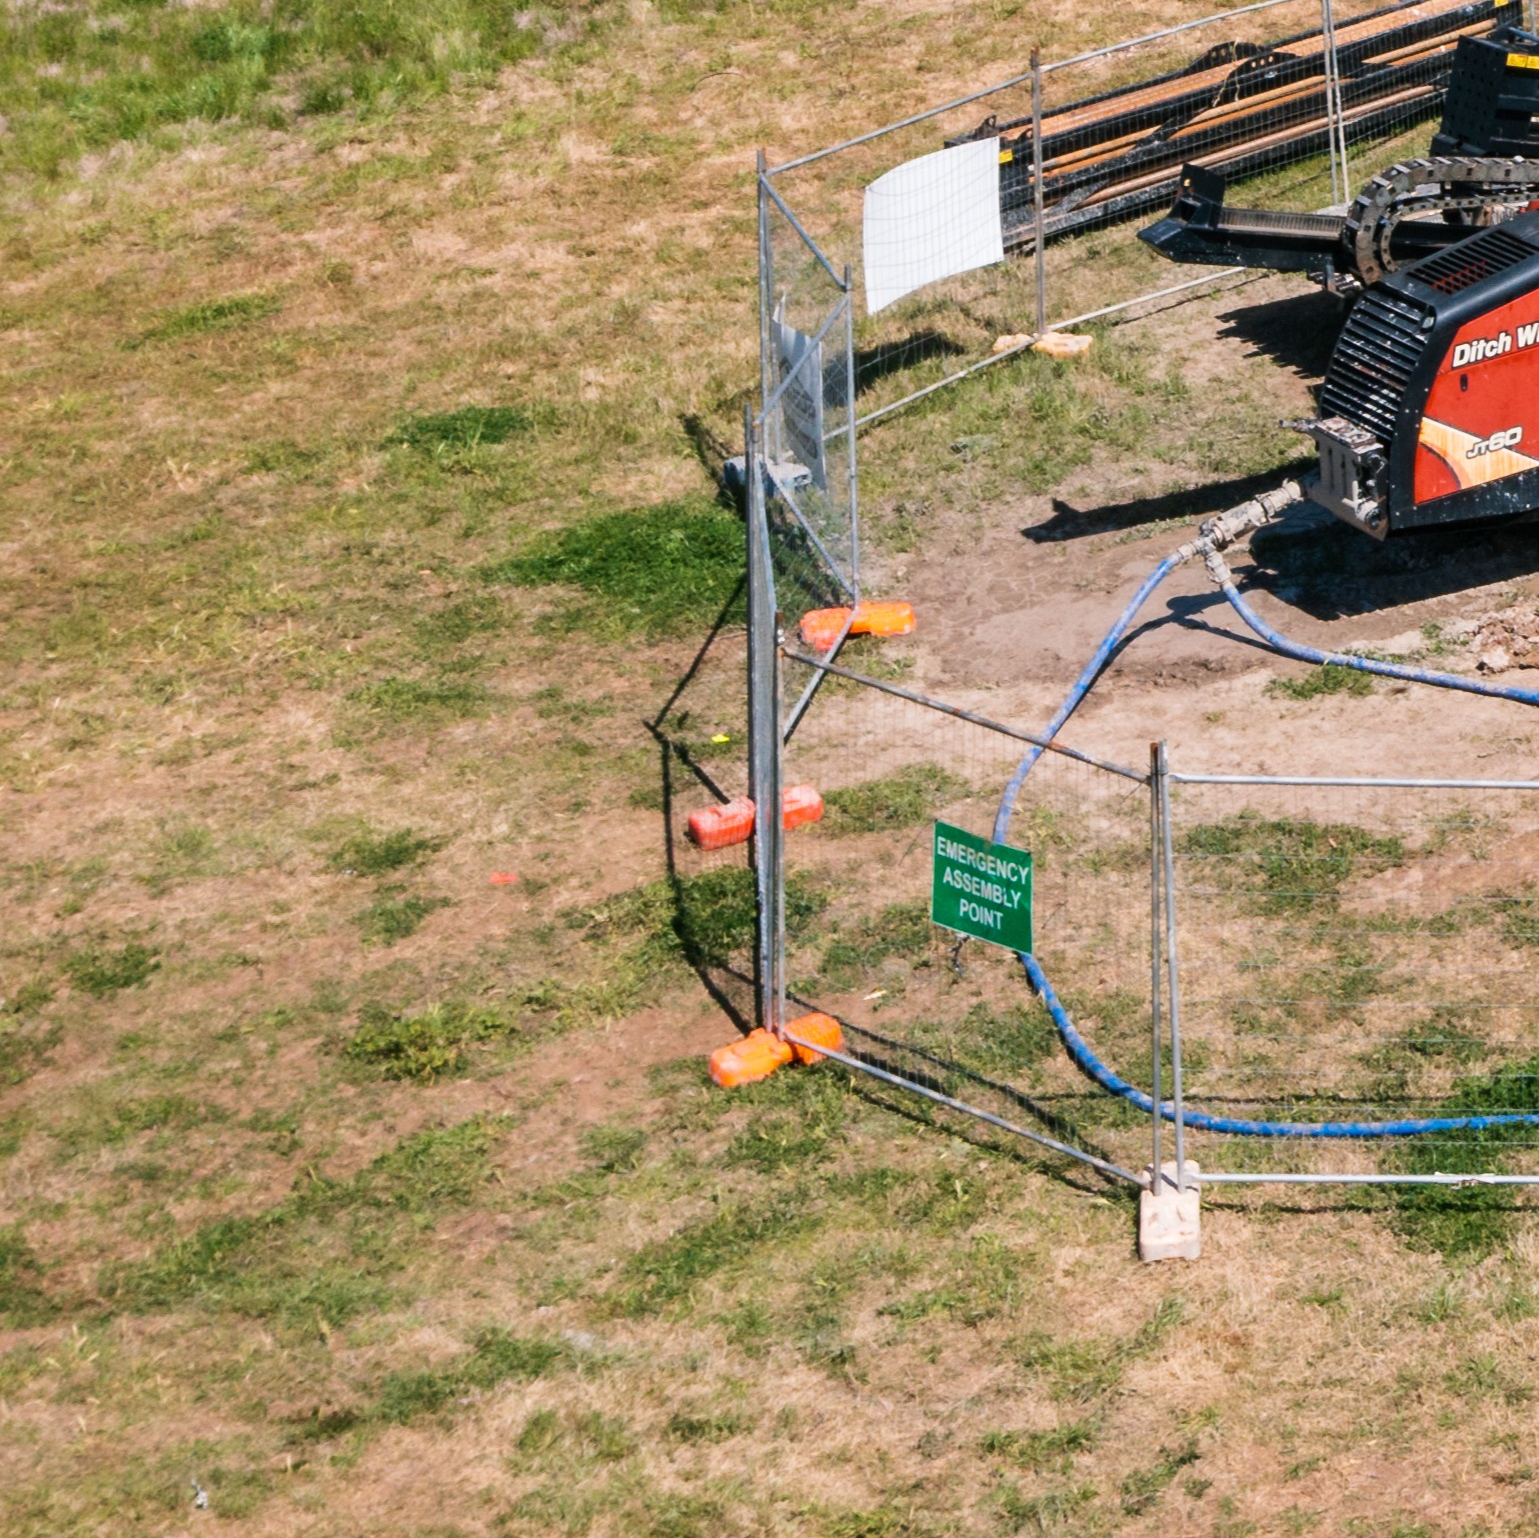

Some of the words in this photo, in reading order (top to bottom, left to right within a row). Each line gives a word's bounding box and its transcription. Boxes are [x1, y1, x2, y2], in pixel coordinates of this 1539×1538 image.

[1452, 331, 1512, 369] Ditch
[1466, 426, 1523, 459] JT60
[936, 835, 1029, 884] EMERGENCY
[943, 866, 1021, 909] ASSEMBLY
[959, 898, 1003, 929] POINT
